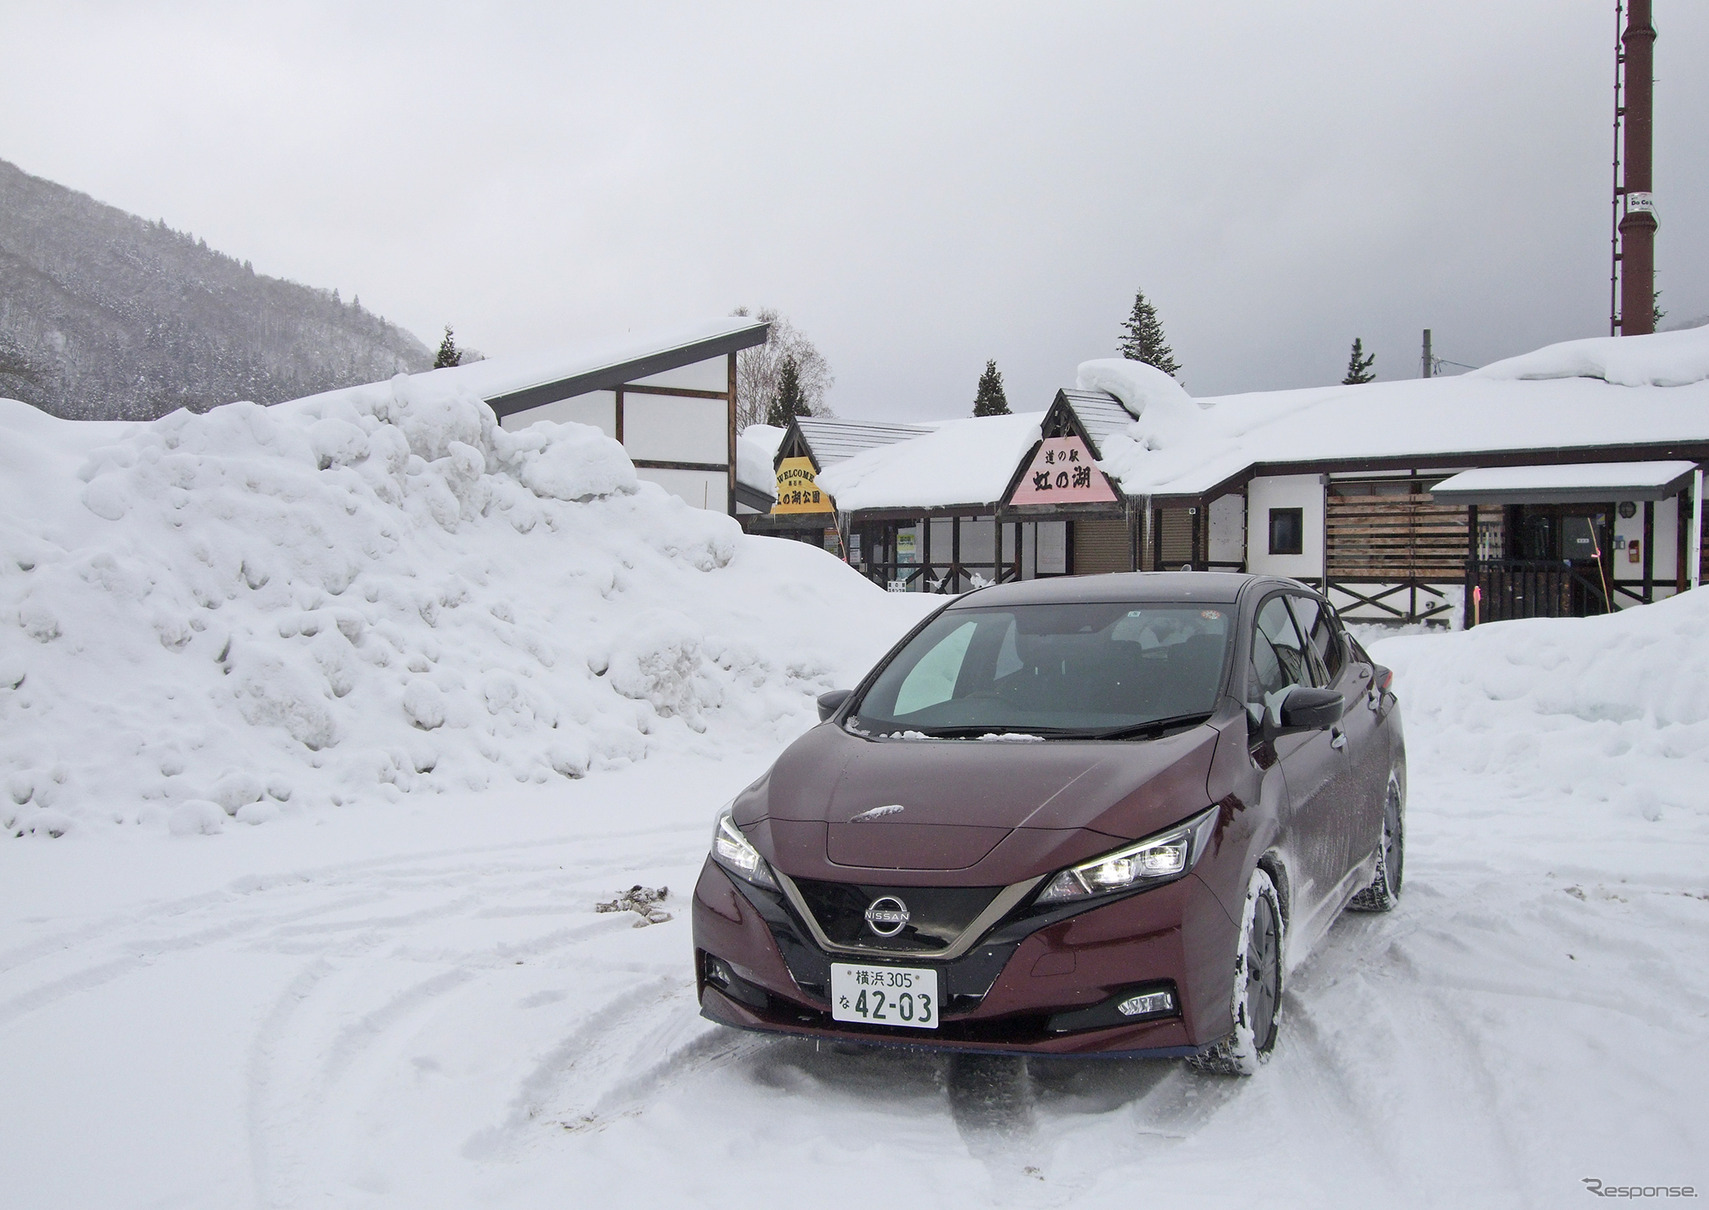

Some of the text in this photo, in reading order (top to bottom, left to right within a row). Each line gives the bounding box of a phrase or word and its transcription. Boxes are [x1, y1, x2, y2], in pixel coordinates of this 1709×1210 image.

[1045, 448, 1080, 465] 道の駅
[776, 468, 815, 484] WELCOME
[1032, 465, 1091, 491] 虹の湖
[864, 911, 910, 920] NISSAN
[839, 989, 932, 1023] な 42-03
